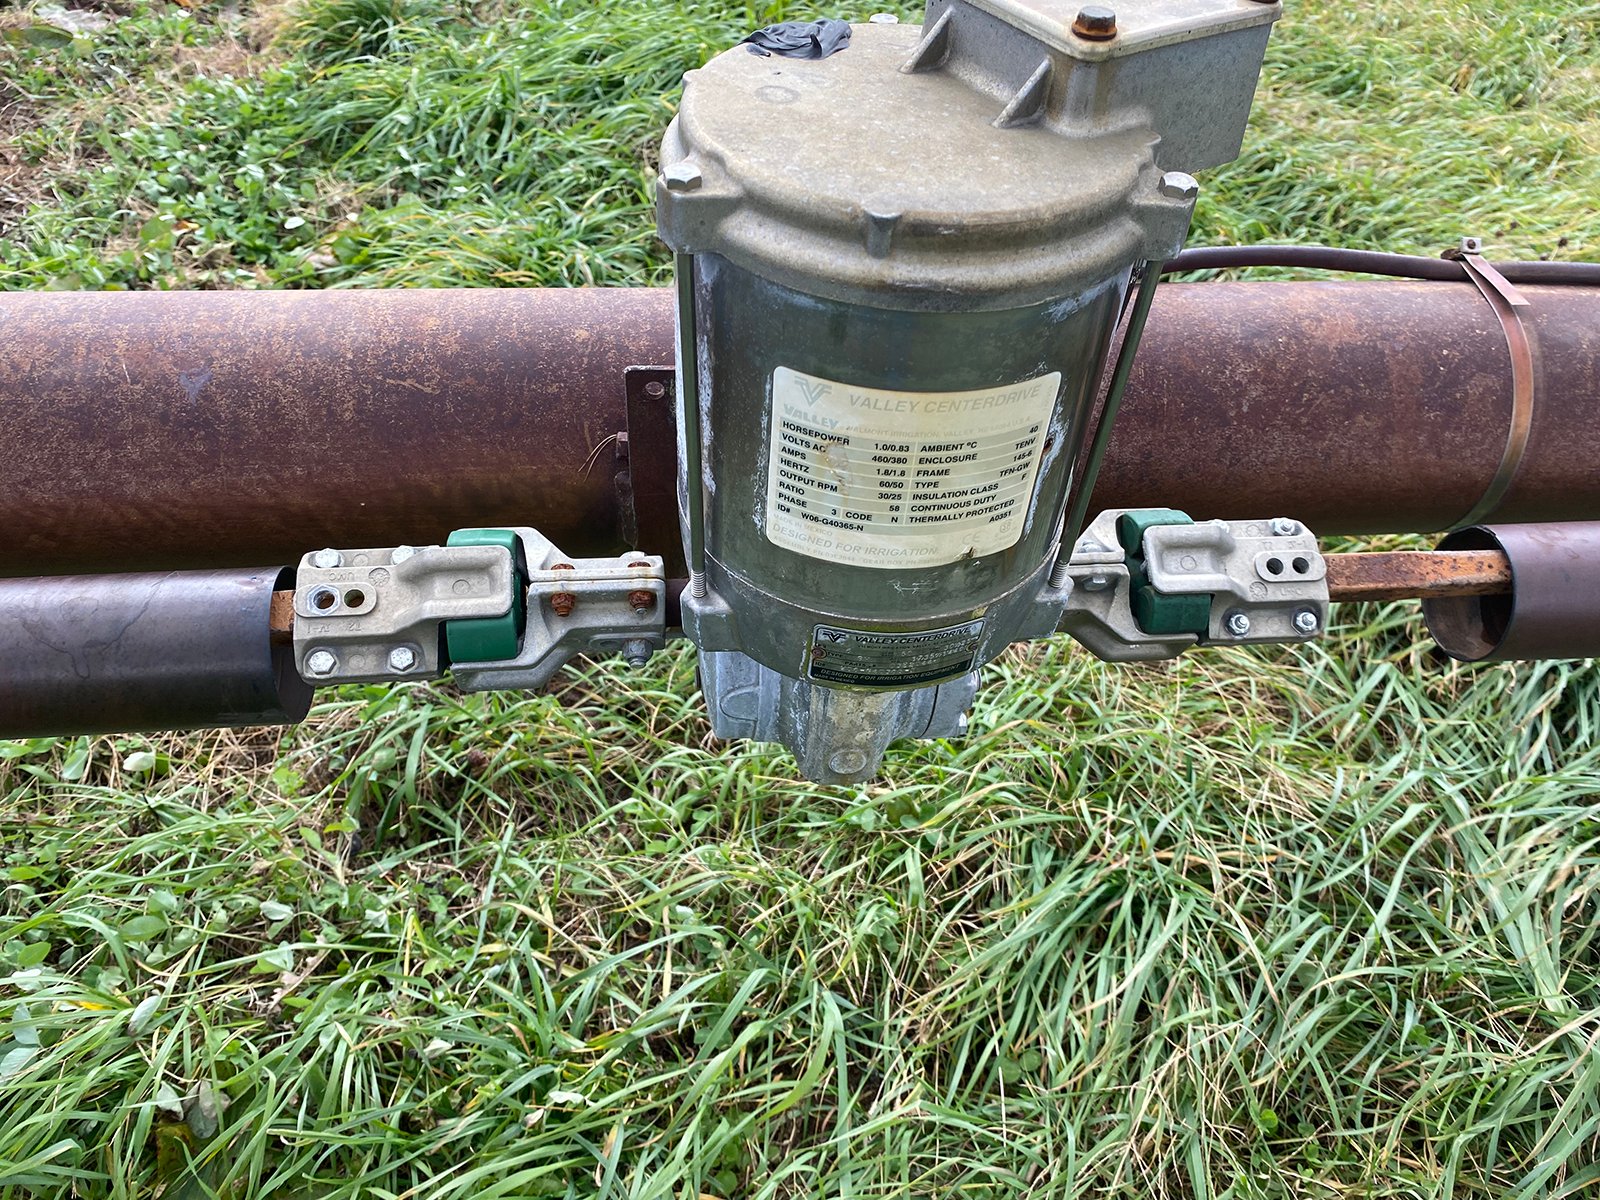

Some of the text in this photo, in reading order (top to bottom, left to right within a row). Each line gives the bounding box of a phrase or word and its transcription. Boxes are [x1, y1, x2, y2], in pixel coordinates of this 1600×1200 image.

[850, 385, 1041, 413] VALLEY CENTERDRIVE
[783, 404, 839, 429] VALLEY
[782, 432, 907, 464] VOLTS AC 460/380
[783, 421, 910, 453] HORSEPOWER 1.0/0.83
[921, 443, 963, 452] AMBIENT
[1029, 425, 1039, 434] 40
[781, 445, 905, 476] AMPS 1.8/1.8
[917, 450, 1032, 477] FRAME 145-6
[919, 438, 1036, 464] ENCLOSURE TENV
[781, 457, 809, 473] HERTZ
[999, 461, 1030, 477] TFN-GW
[779, 481, 805, 495] RATIO
[780, 469, 902, 500] OUTPUT RPM 30/25
[913, 473, 1027, 500] INSULATION CLASS F
[778, 492, 807, 508] PHASE
[845, 511, 872, 521] CODE
[910, 499, 1014, 523] THERMALLY PROTECTED
[911, 494, 997, 512] CONTINUOUS DUTY
[778, 503, 1012, 531] ID# W06-G40365-N A0351
[772, 523, 833, 548] DESIGNED
[836, 543, 862, 554] FOR
[855, 636, 898, 644] VALLEY
[900, 626, 972, 644] CENTERDRIVE
[821, 669, 858, 680] DESIGNED
[877, 672, 919, 682] IRRIGATION
[920, 664, 961, 678] EQUIPMENT
